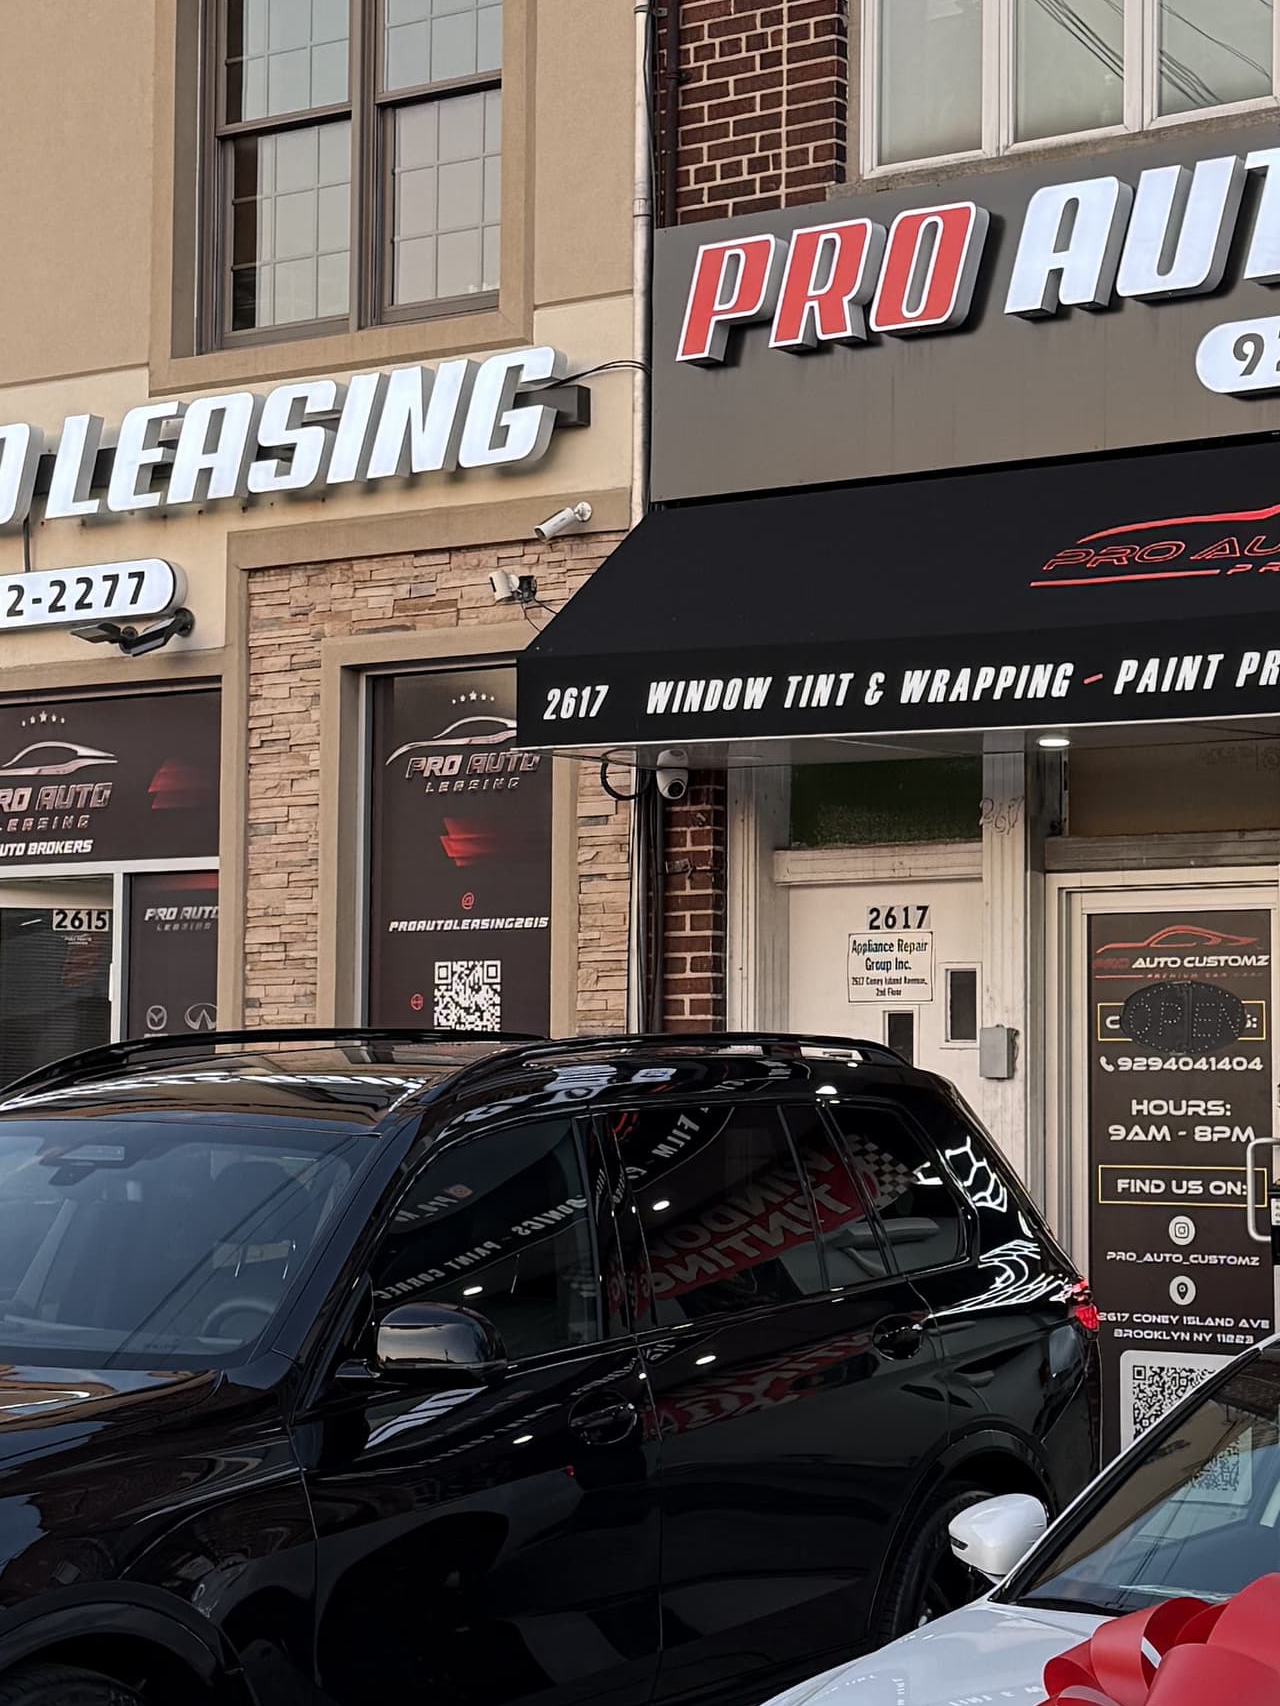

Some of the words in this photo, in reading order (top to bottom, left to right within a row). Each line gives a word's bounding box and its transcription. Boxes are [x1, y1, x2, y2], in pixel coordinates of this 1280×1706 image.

[676, 199, 984, 365] PRO
[45, 346, 560, 520] LEASING
[1044, 541, 1187, 570] PRO
[542, 684, 610, 722] 2617
[645, 675, 773, 716] WINDOW
[783, 672, 855, 709] TINT
[899, 662, 1074, 705] WRAPPING
[1113, 653, 1224, 695] PAINT
[405, 753, 464, 779] PRO
[466, 750, 541, 778] AUTO
[424, 776, 522, 794] LEASING
[35, 782, 113, 811] AUTO
[27, 839, 94, 857] BROKERS
[55, 910, 108, 930] 2615
[144, 906, 179, 921] PRO
[868, 905, 930, 930] 2617
[388, 917, 550, 933] PROAUTOLEASING2615
[851, 938, 895, 956] Appliance
[897, 938, 928, 955] Repair
[865, 956, 892, 973] Group
[895, 956, 912, 970] Inc.
[1131, 955, 1181, 969] AUTO
[1183, 954, 1270, 968] CUSTOMZ
[1117, 1056, 1264, 1072] 9294041404
[1131, 1099, 1232, 1117] HOURS:
[1108, 1125, 1171, 1142] 9AM
[1194, 1125, 1256, 1143] 8PM
[1117, 1179, 1165, 1193] FIND
[1171, 1179, 1204, 1195] US
[1209, 1180, 1248, 1196] ON:
[1106, 1251, 1261, 1267] PRO_AUTO_CUSTOMZ
[1098, 1312, 1130, 1322] 2617
[1132, 1313, 1180, 1325] CONEY
[1183, 1315, 1235, 1328] ISLAND
[1238, 1318, 1270, 1330] AVE
[1113, 1328, 1190, 1342] BROOKLYN
[1193, 1332, 1213, 1342] NY
